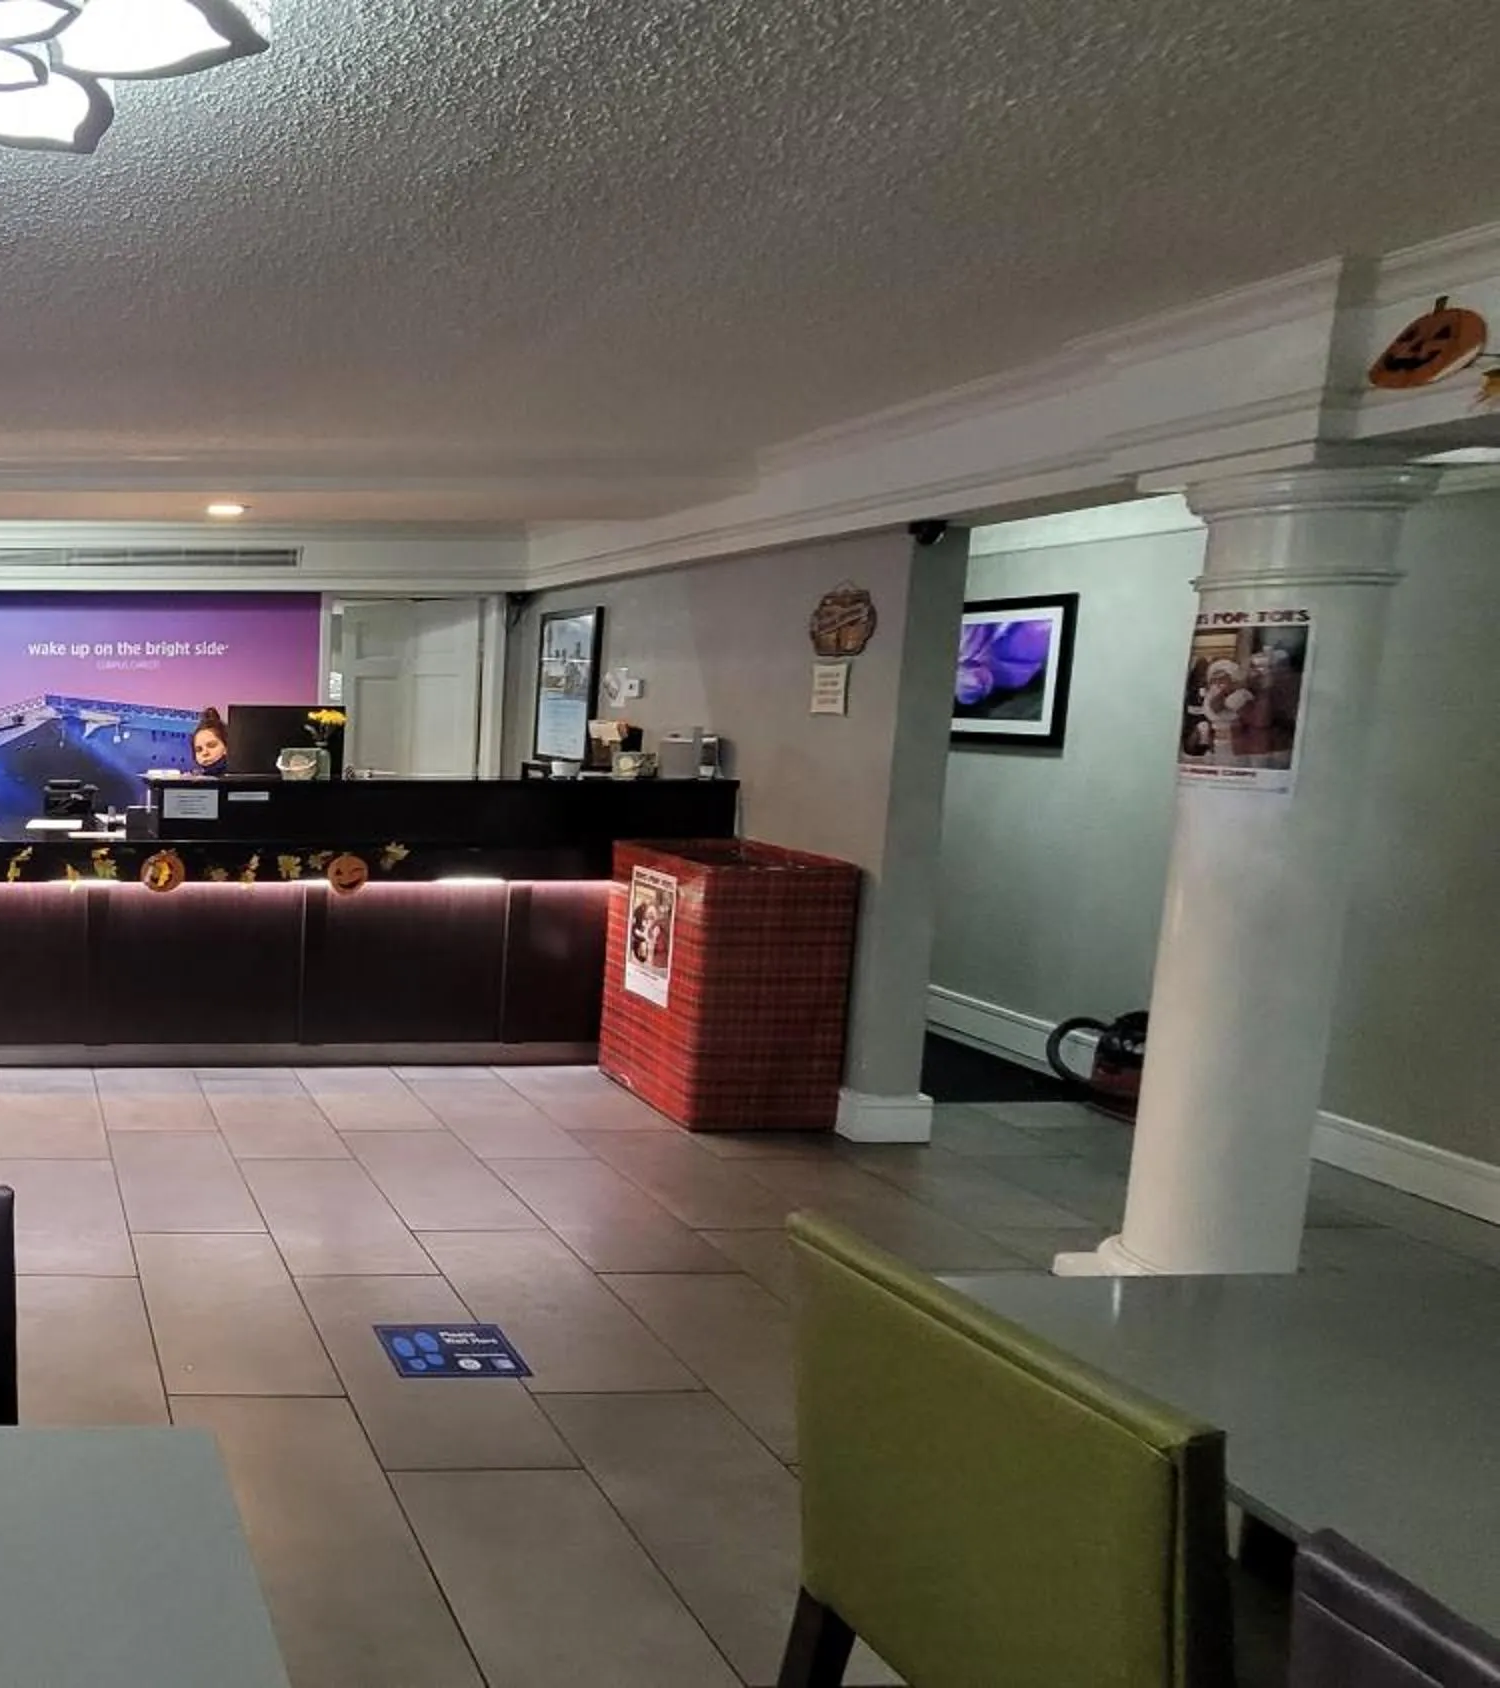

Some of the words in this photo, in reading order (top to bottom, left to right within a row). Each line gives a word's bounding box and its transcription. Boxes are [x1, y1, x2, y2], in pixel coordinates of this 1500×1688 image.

[28, 641, 65, 656] wake
[71, 644, 90, 659] up
[95, 644, 113, 656] on
[117, 641, 141, 656] the
[146, 641, 190, 659] bright
